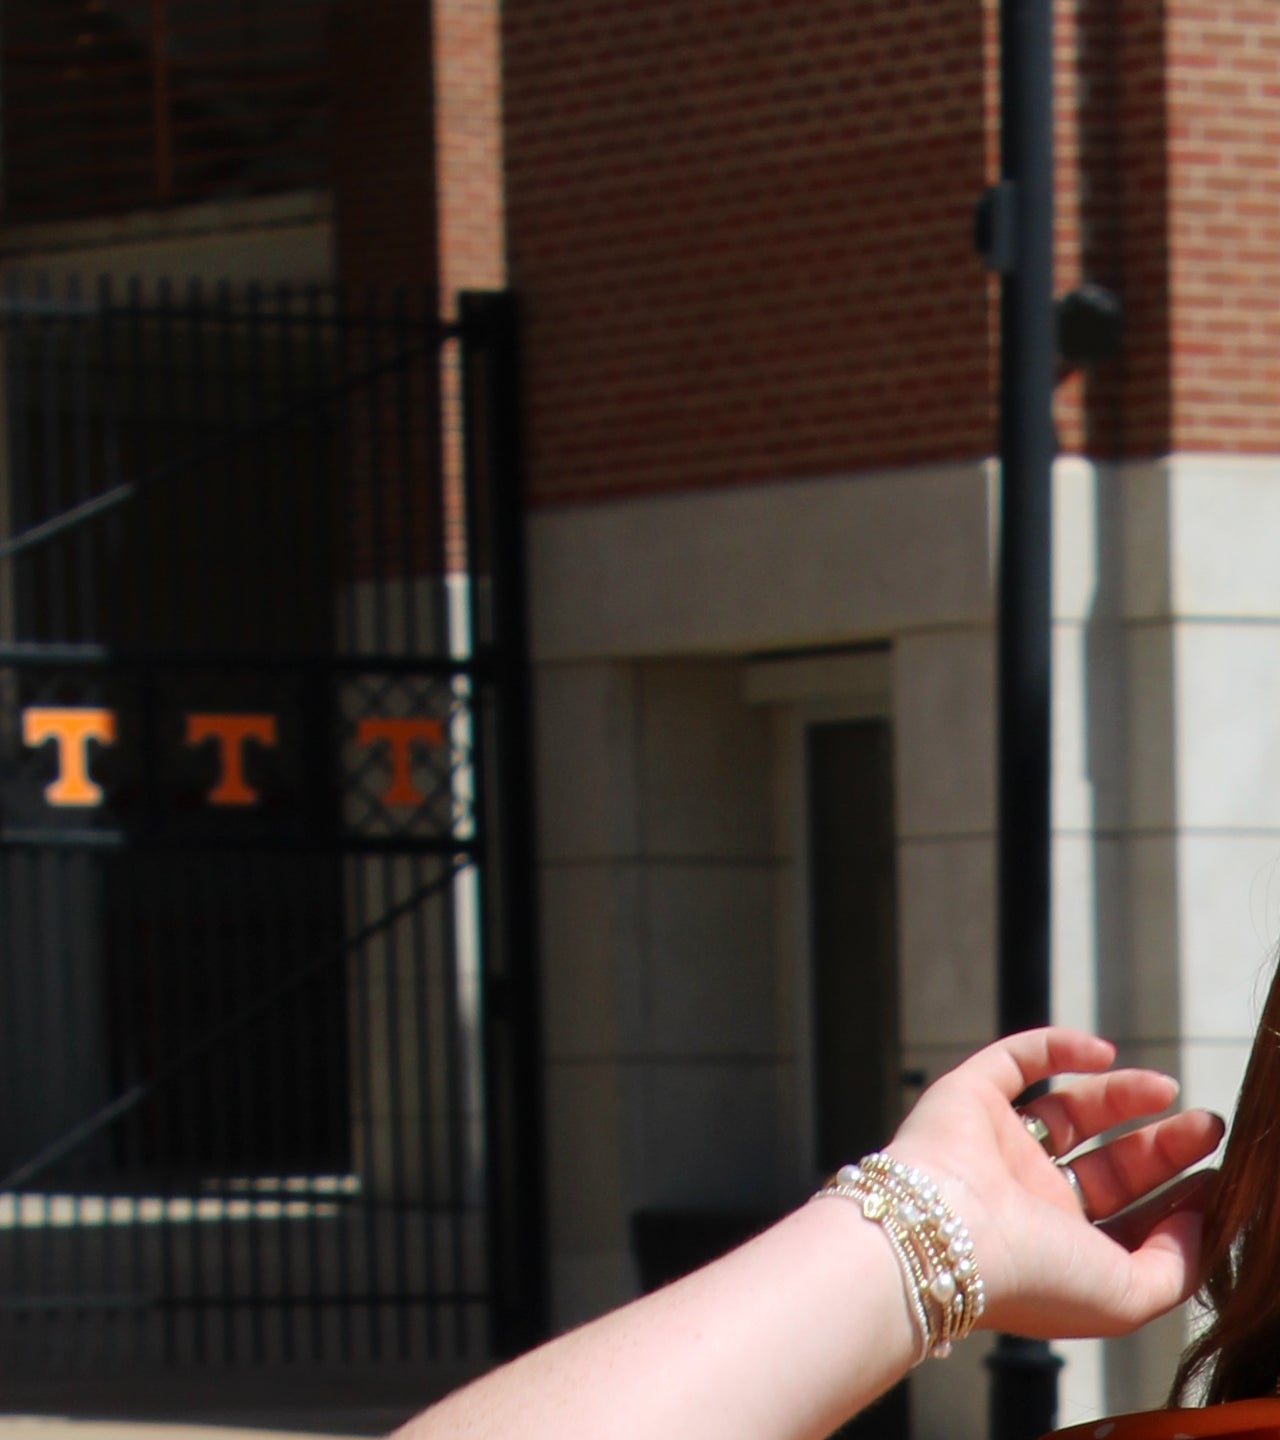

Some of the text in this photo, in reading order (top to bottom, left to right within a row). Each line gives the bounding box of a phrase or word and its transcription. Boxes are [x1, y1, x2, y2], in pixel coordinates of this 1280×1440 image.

[23, 708, 116, 806] T
[186, 713, 276, 806] T
[356, 716, 444, 808] T
